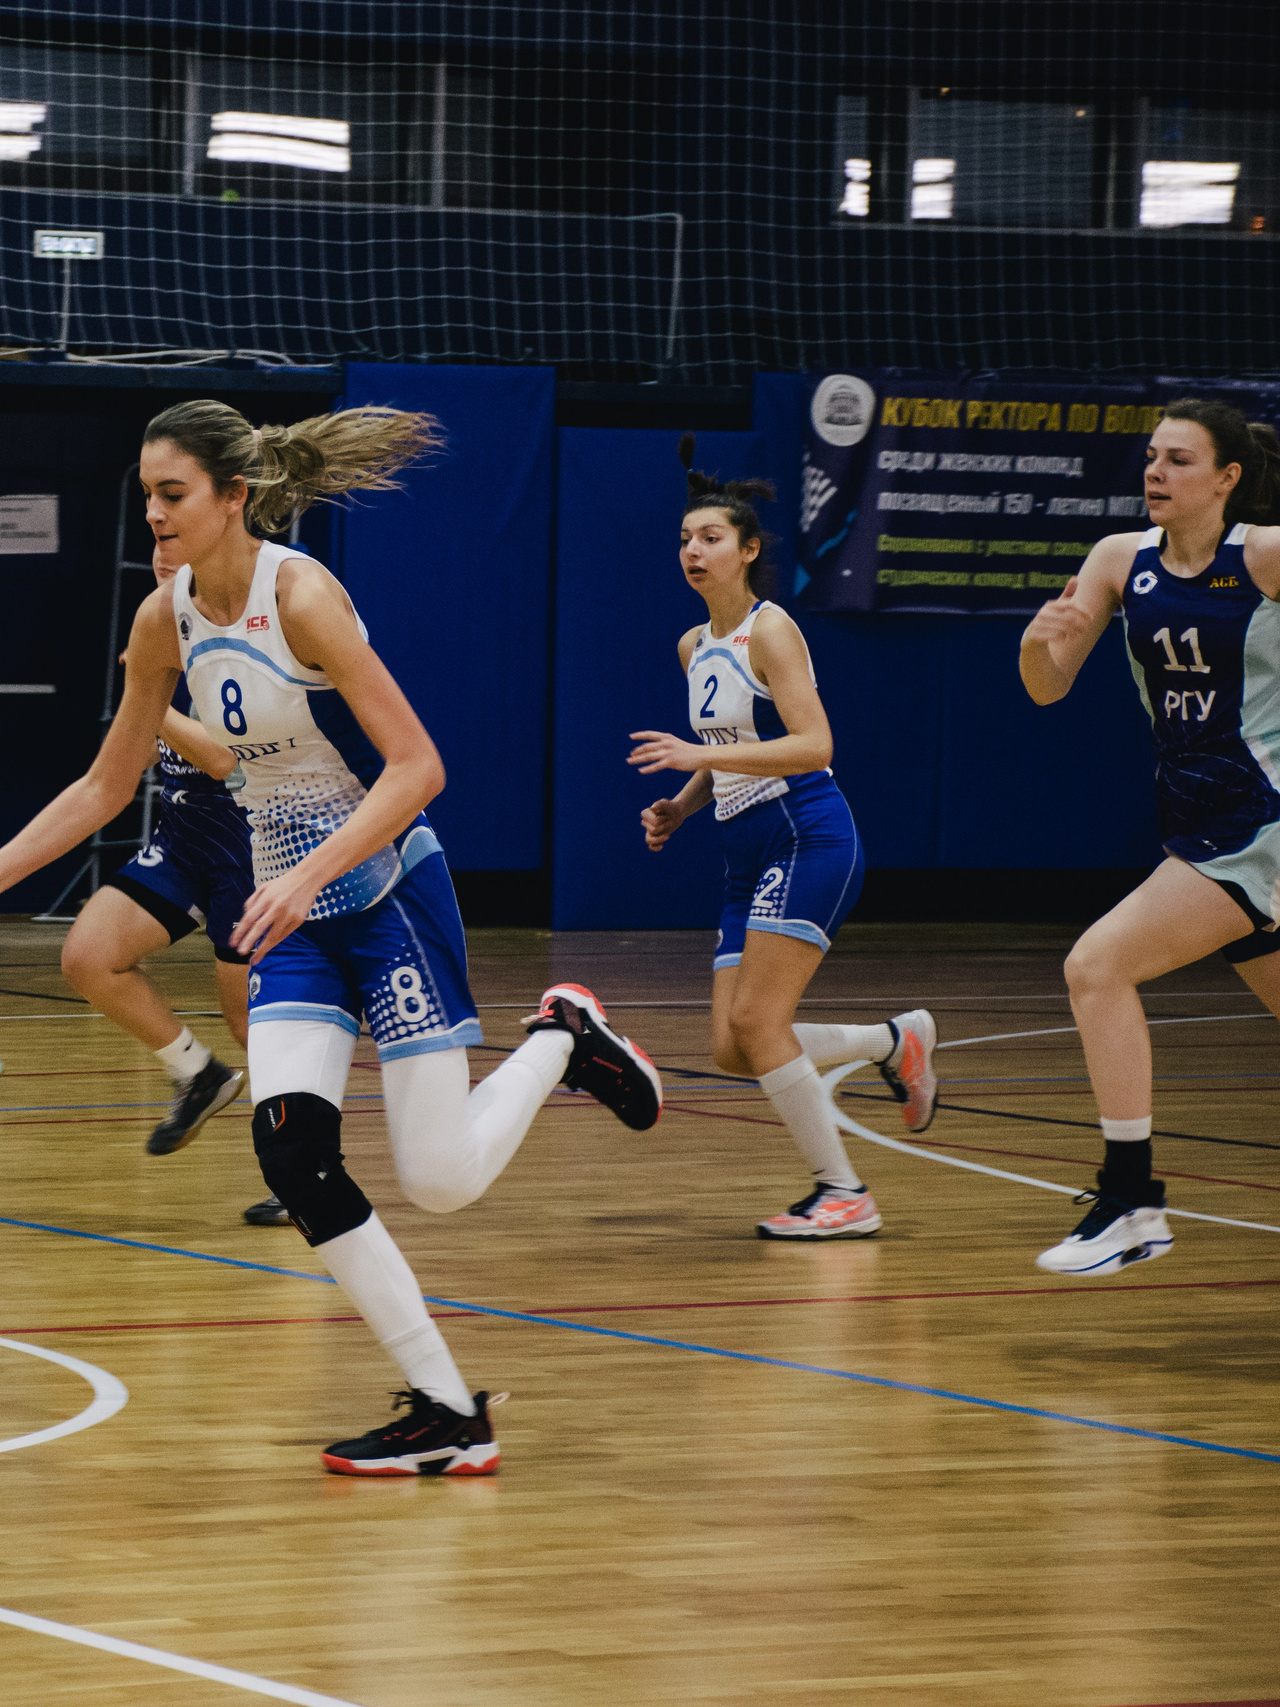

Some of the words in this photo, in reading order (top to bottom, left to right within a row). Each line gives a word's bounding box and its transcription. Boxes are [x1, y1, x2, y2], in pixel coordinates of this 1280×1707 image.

[881, 397, 964, 429] КУБОК
[965, 400, 1062, 432] РЕКТОРА
[1066, 404, 1100, 433] ПО
[1153, 627, 1211, 674] 11
[221, 678, 248, 736] 8
[699, 674, 718, 718] 2
[1164, 690, 1216, 721] РГУ
[754, 866, 784, 908] 2
[391, 966, 428, 1023] 8
